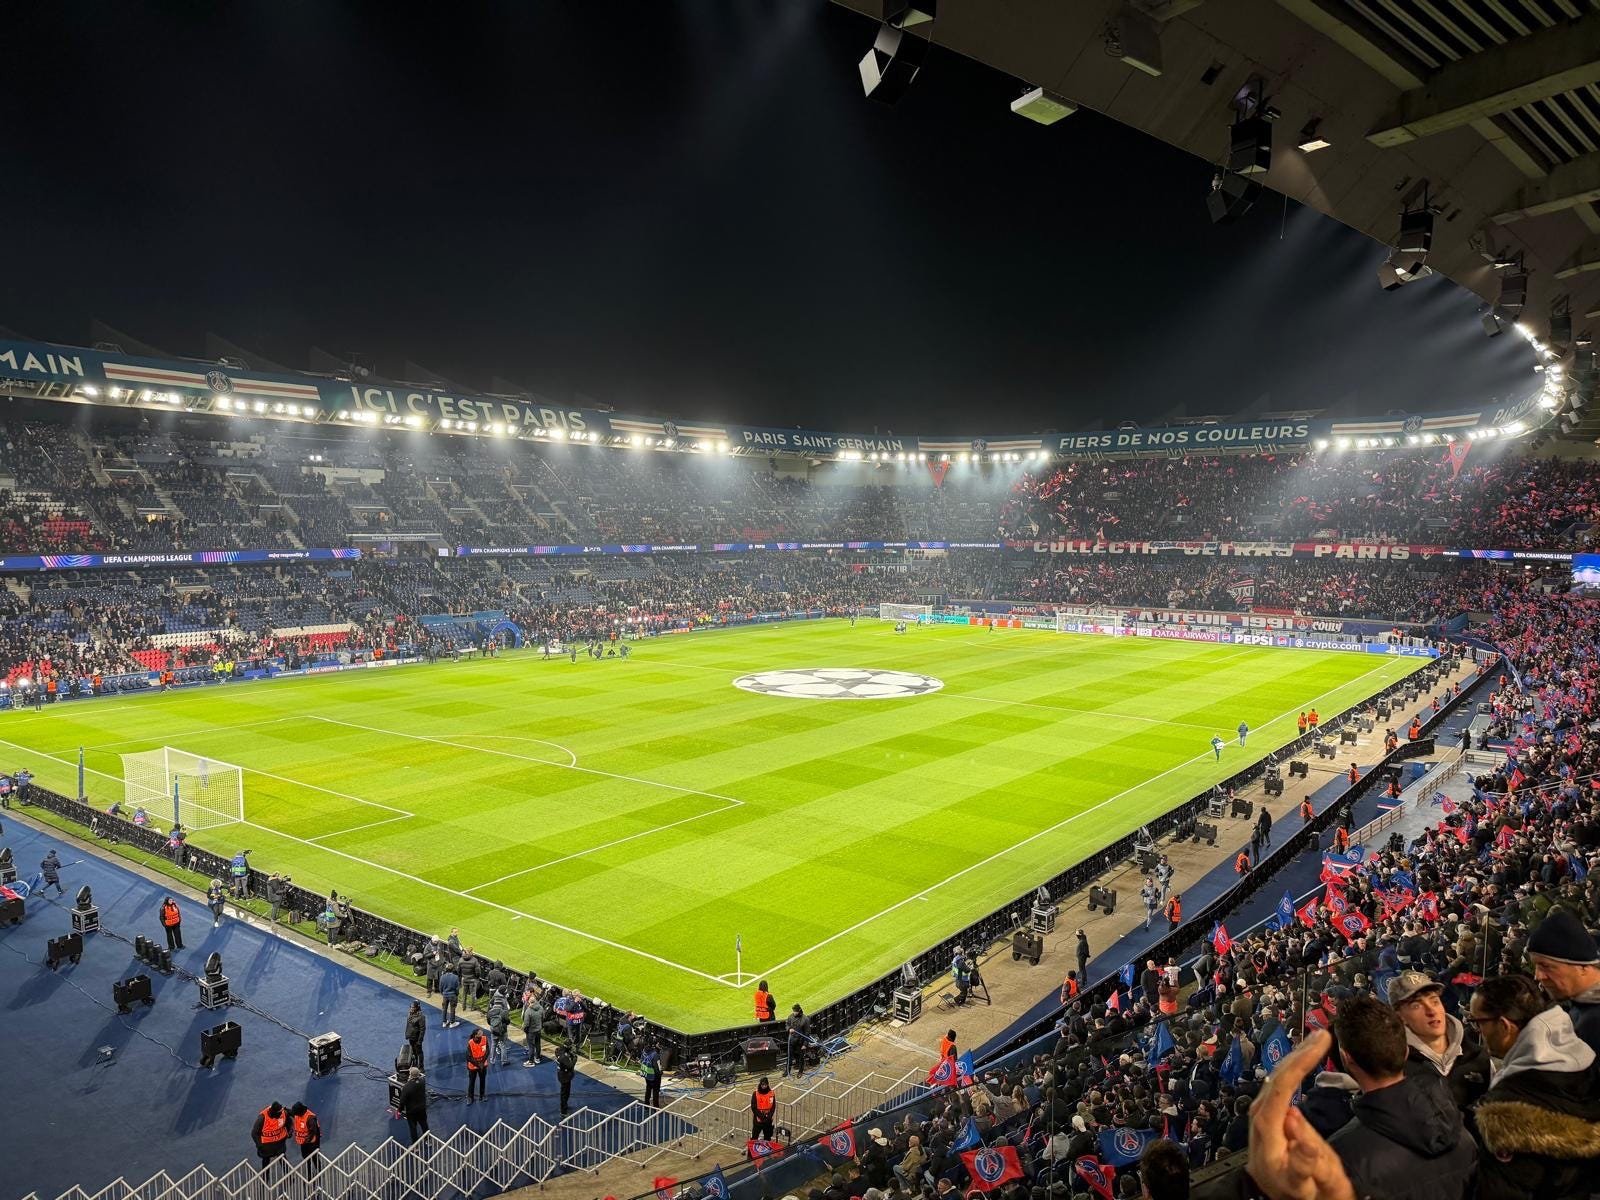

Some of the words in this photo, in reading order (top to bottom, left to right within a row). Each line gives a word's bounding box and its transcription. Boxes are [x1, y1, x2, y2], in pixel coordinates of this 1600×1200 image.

[351, 386, 398, 413] ICI
[406, 392, 494, 423] C'EST
[502, 404, 587, 431] PARIS
[743, 431, 787, 446] PARIS
[793, 434, 904, 451] SAINT-GERMAIN
[1059, 435, 1112, 449] FIERS
[1117, 433, 1142, 447] DE
[1148, 431, 1189, 445] NOS
[1195, 425, 1309, 443] COULEURS
[103, 556, 122, 564] UEFA
[123, 555, 165, 564] CHAMPIONS
[166, 554, 193, 562] LEAGUE
[1314, 545, 1410, 560] PARIS
[1240, 616, 1293, 630] 1991
[1154, 629, 1180, 638] QATAR
[1183, 630, 1216, 640] AIRWAYS
[1234, 634, 1273, 646] PEPSI
[1306, 640, 1361, 652] crypto.com
[1401, 646, 1430, 655] PS5
